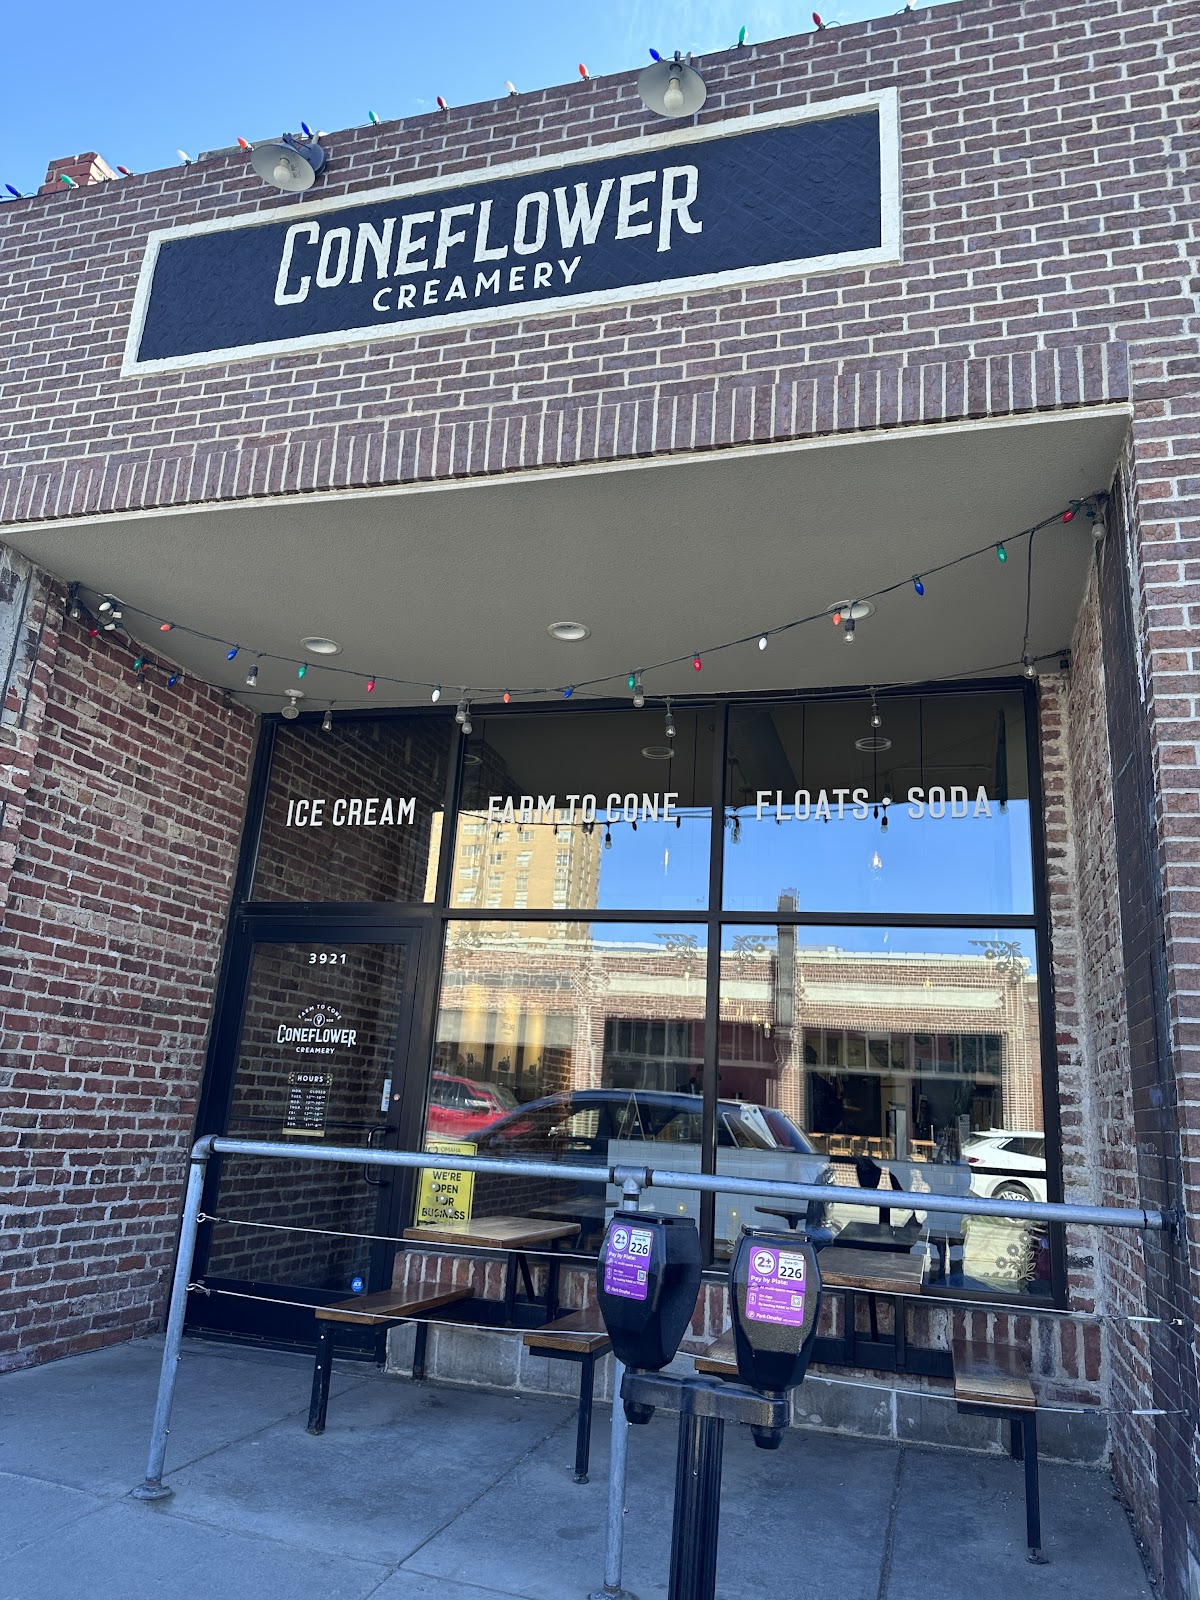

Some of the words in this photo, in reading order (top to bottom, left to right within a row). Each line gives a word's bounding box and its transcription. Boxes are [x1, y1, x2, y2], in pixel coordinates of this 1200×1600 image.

[274, 164, 703, 306] CONEFLOWER
[372, 256, 582, 312] CREAMERY
[487, 795, 555, 824] FARM
[565, 793, 597, 823] TO
[605, 792, 680, 823] CONE
[755, 788, 869, 821] FLOATS
[907, 785, 993, 820] SODA
[286, 799, 326, 827] ICE
[332, 797, 417, 826] CREAM
[308, 953, 347, 965] 3921
[298, 1005, 315, 1020] FARM
[327, 1005, 342, 1020] CONE
[276, 1024, 357, 1047] CONEFLOWER
[295, 1046, 335, 1054] CREAMERY
[297, 1075, 324, 1083] HOURS
[432, 1170, 462, 1182] WE'RE
[421, 1207, 466, 1220] BUSINSS
[629, 1242, 649, 1255] 226
[608, 1251, 616, 1259] Pay
[623, 1253, 637, 1261] Plate:
[779, 1266, 802, 1279] 226
